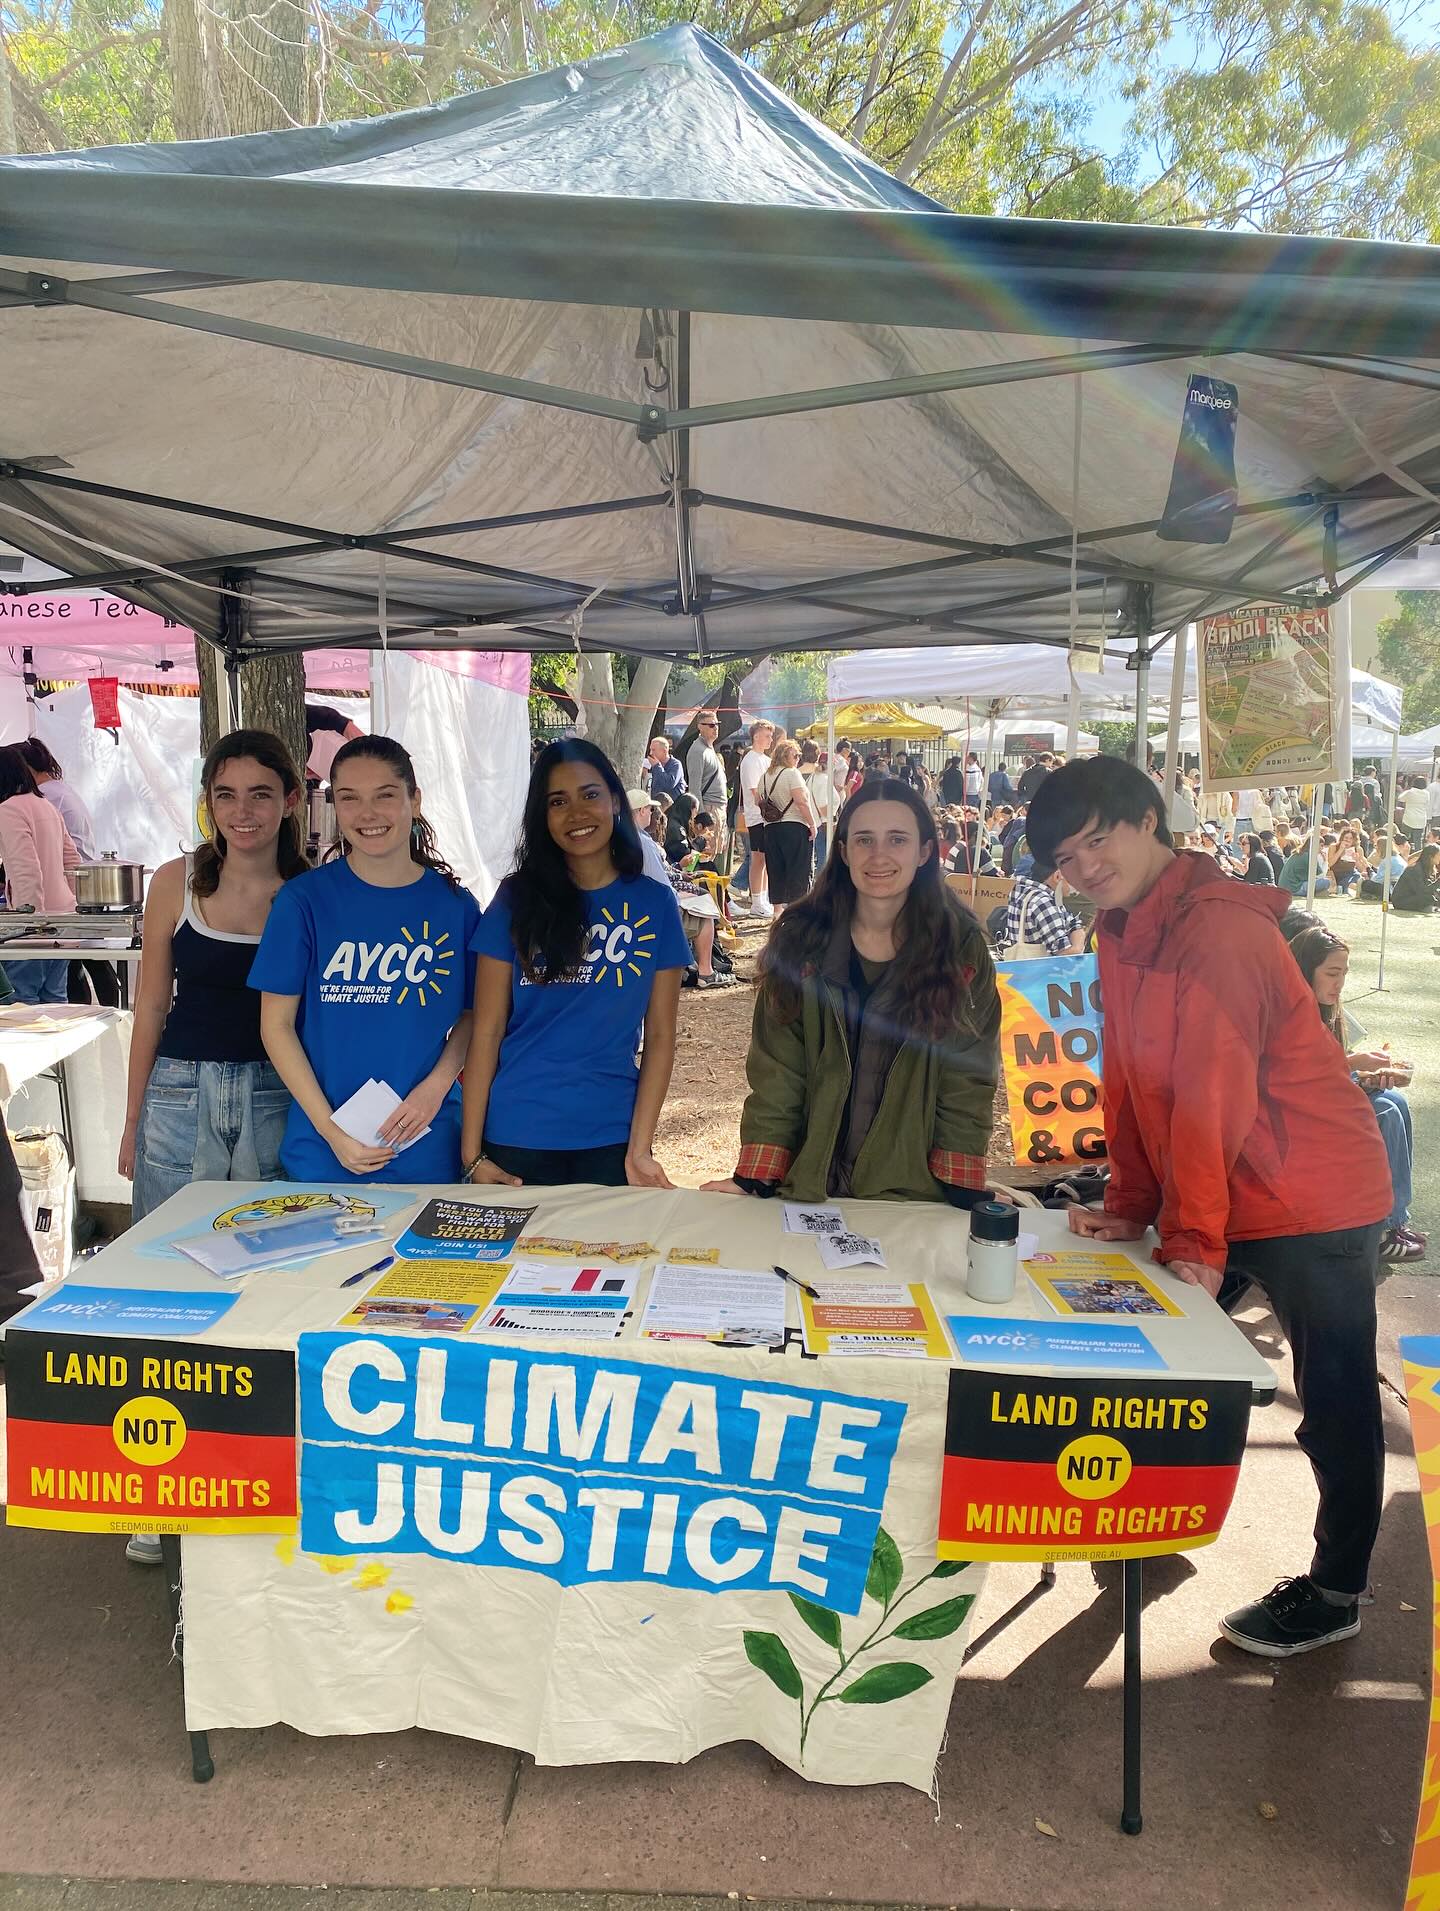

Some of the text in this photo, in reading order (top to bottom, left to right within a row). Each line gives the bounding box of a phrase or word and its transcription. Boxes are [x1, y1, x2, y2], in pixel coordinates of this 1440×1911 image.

[89, 598, 139, 618] Tea
[1206, 615, 1326, 644] BONDI BEACH
[322, 941, 433, 983] AYCC
[577, 965, 593, 974] FOR
[320, 993, 390, 1004] LIMATE JUSTICE
[341, 985, 375, 994] FIGHTING
[376, 986, 392, 994] FOR
[1014, 1028, 1104, 1066] MO
[1023, 1079, 1105, 1116] CO
[435, 1202, 458, 1210] ARE
[436, 1212, 462, 1220] WHO
[466, 1216, 505, 1224] WANTS
[432, 1230, 506, 1240] JUSTICE!
[437, 1224, 507, 1235] CLIMATE
[447, 1219, 480, 1227] FIGHT
[41, 1303, 107, 1315] AYCC
[967, 1334, 1026, 1346] AYCC
[45, 1351, 254, 1397] LAND RIGHTS
[320, 1338, 883, 1494] CLIMATE
[991, 1391, 1209, 1430] LAND RIGHTS
[123, 1418, 177, 1446] NOT
[1066, 1455, 1123, 1481] NOT
[31, 1466, 271, 1508] MINING RIGHTS
[333, 1462, 844, 1598] JUSTICE
[966, 1502, 1207, 1535] MINING RIGHTS
